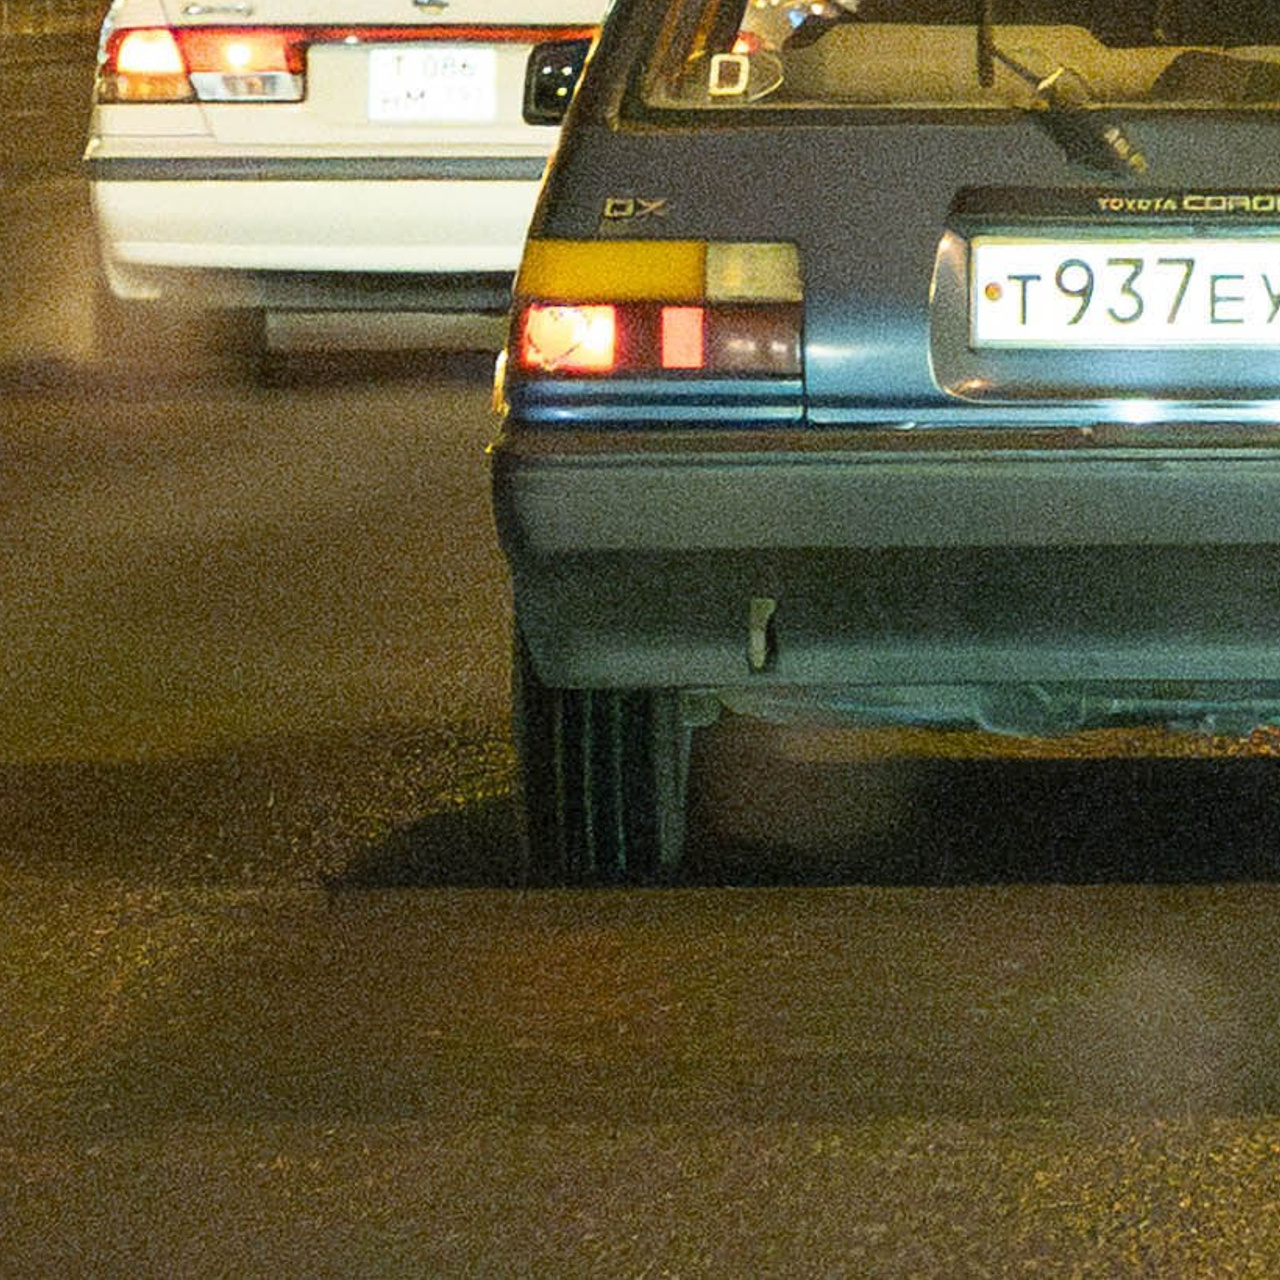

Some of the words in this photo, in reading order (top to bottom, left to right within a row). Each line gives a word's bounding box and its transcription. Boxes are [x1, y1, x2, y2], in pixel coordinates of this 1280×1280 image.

[604, 197, 667, 218] DX
[1098, 197, 1177, 211] TOYOTA
[1183, 194, 1280, 212] CORO
